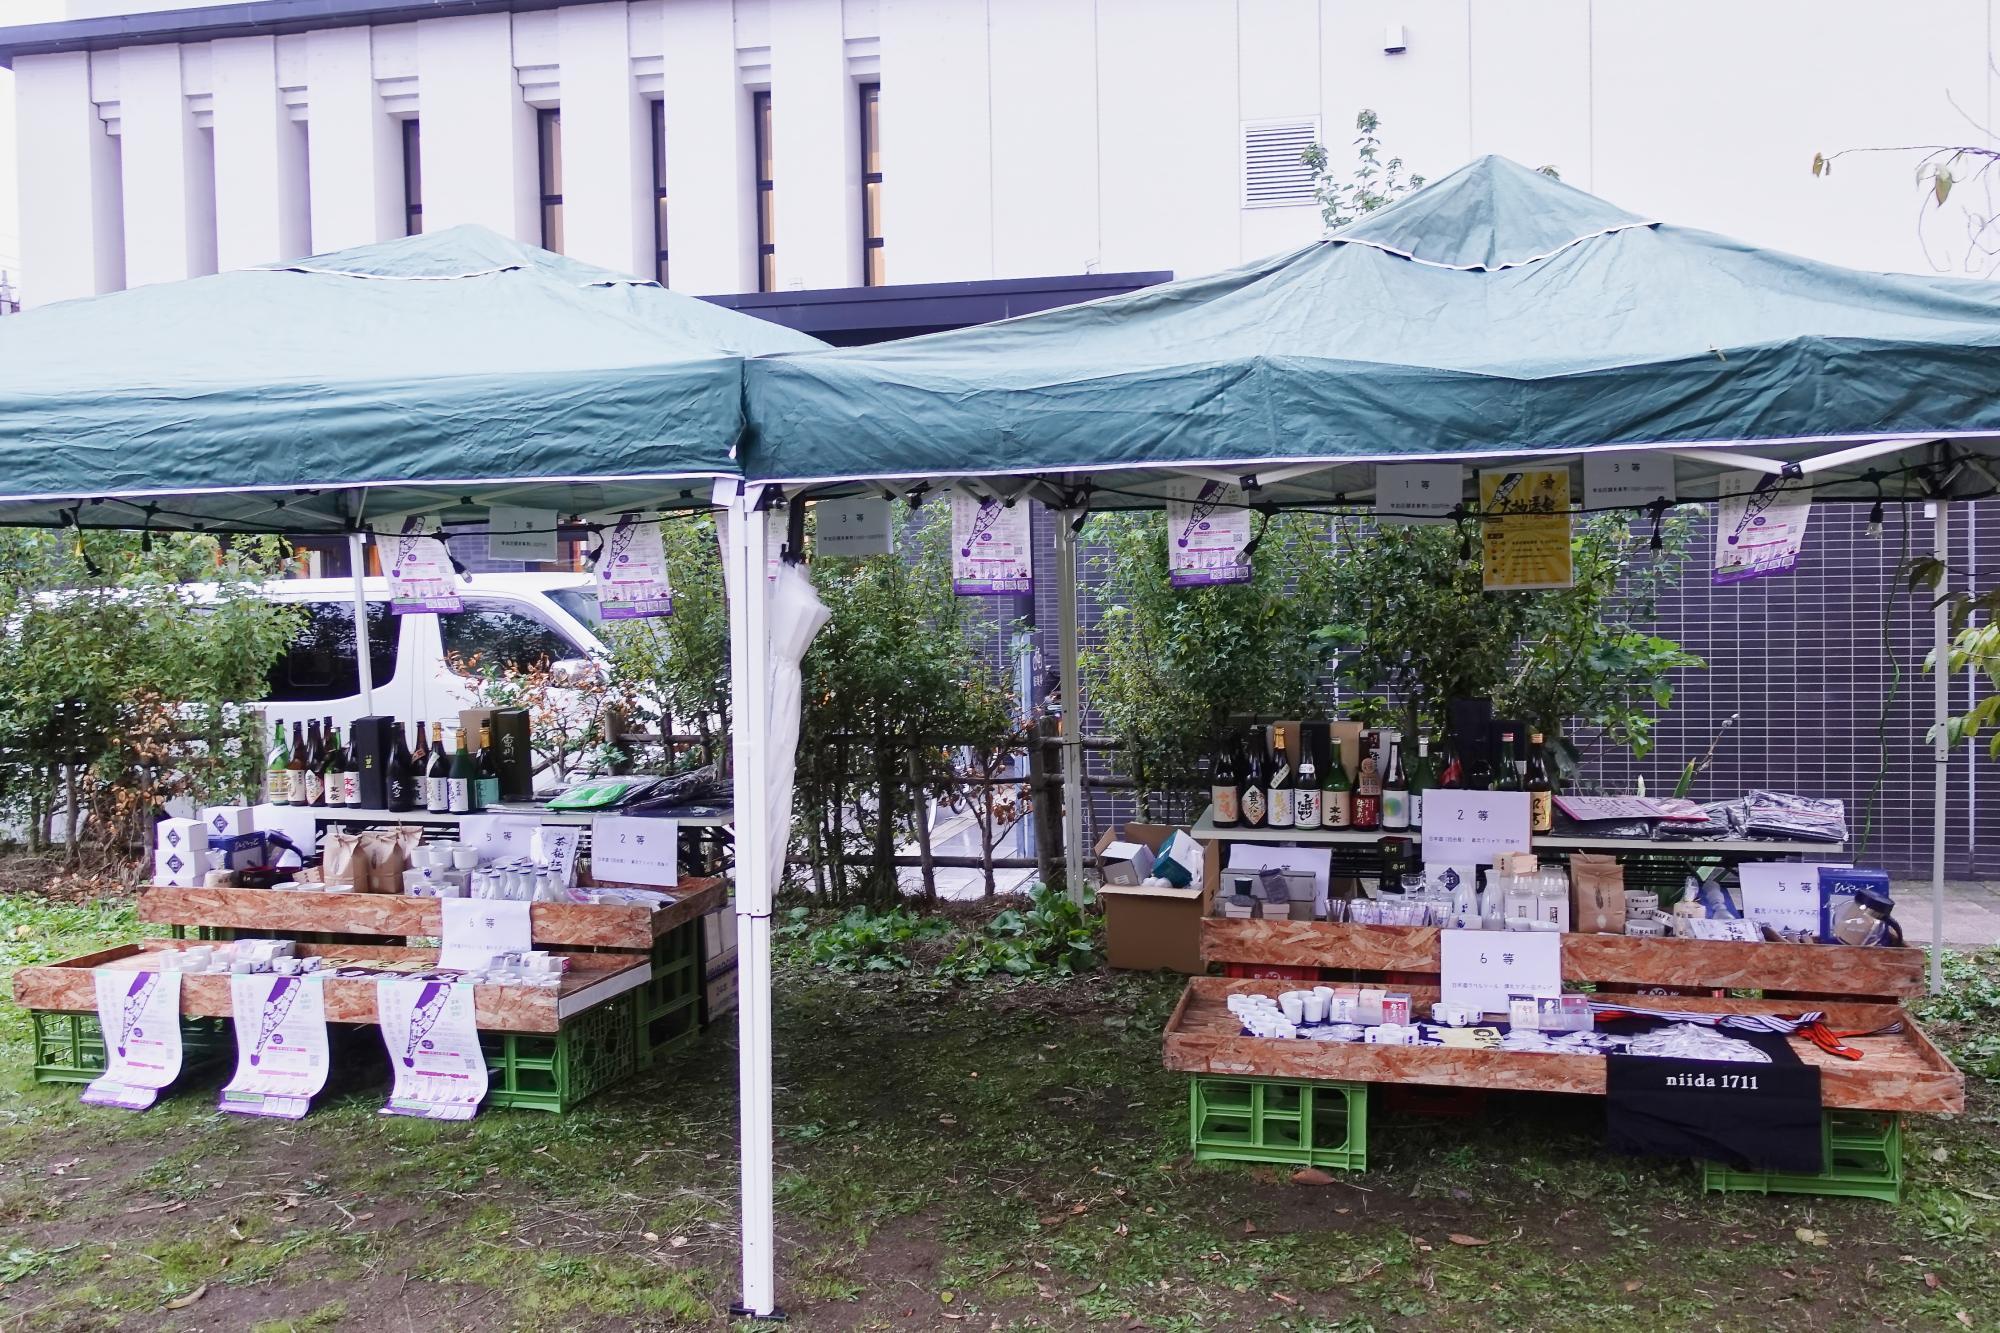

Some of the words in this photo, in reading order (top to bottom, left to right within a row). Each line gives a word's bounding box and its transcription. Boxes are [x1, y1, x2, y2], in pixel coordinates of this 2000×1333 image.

[1457, 809, 1465, 821] 2
[1477, 809, 1490, 822] 等
[486, 832, 492, 842] 5
[503, 831, 513, 842] 等
[620, 833, 626, 844] 2
[635, 835, 646, 845] 等
[1778, 880, 1786, 892] 5
[1800, 882, 1812, 893] 等
[485, 917, 495, 929] 等
[1480, 952, 1488, 964] 6
[1502, 953, 1515, 965] 等
[1666, 1073, 1716, 1088] niida
[1721, 1074, 1759, 1090] 1711
